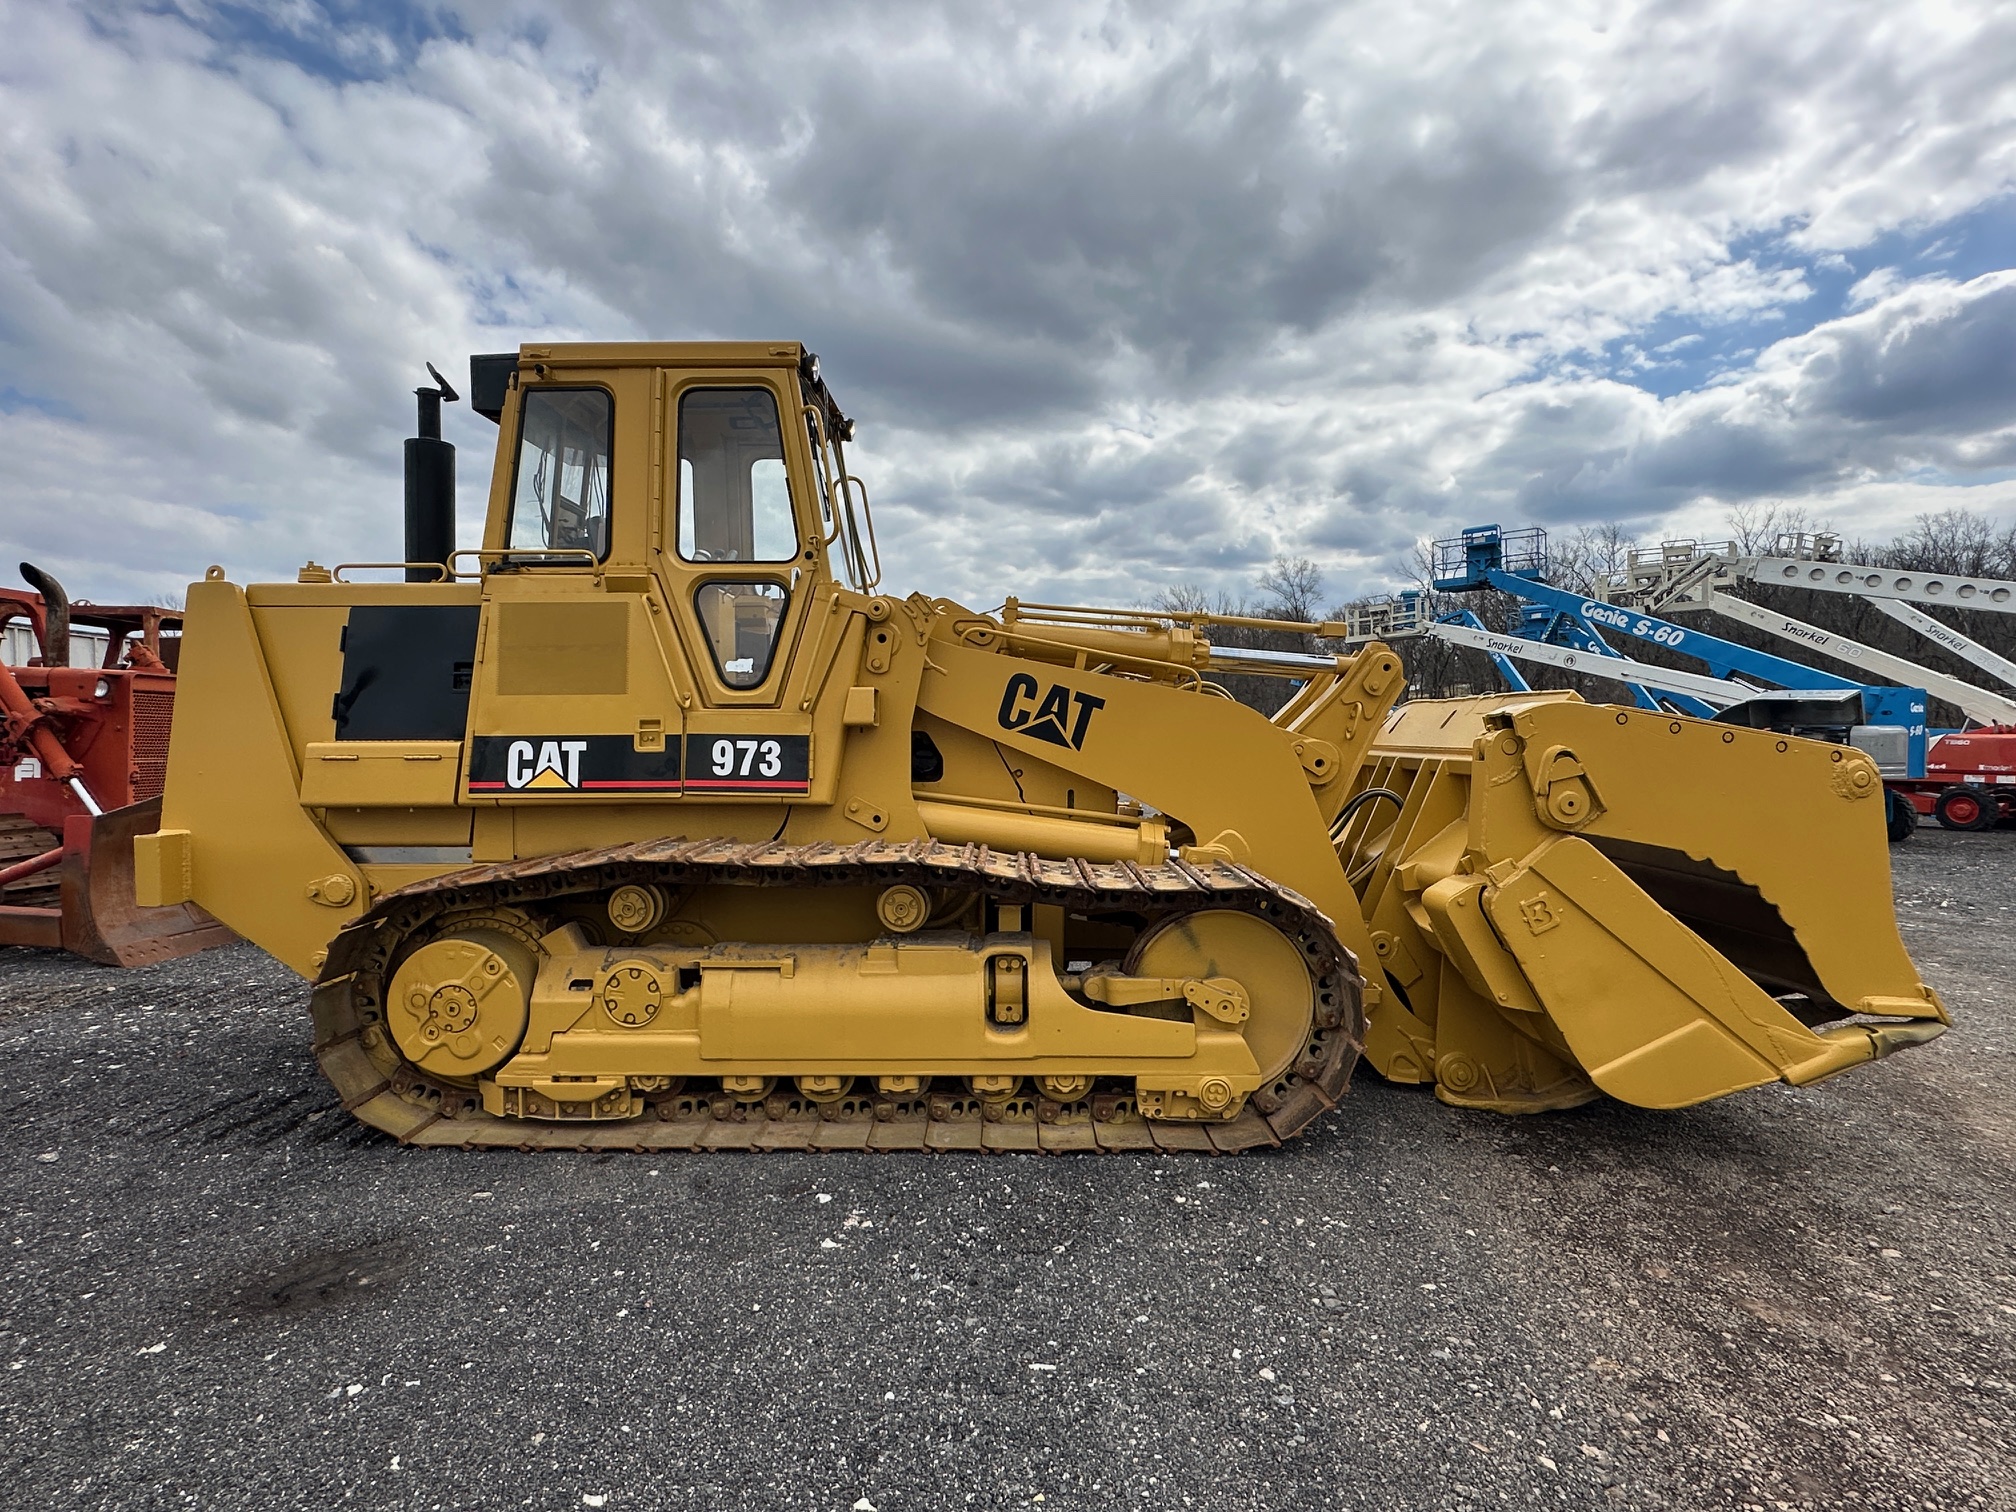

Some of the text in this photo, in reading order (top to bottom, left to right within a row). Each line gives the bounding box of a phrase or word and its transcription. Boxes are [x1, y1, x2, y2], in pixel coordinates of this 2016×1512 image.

[1581, 601, 1685, 646] Genie S-60
[1782, 622, 1863, 658] Snorkel 60
[1925, 625, 1968, 651] Snorkel
[1486, 638, 1524, 654] Snorkel
[998, 672, 1106, 752] CAT
[506, 739, 782, 789] CAT 973
